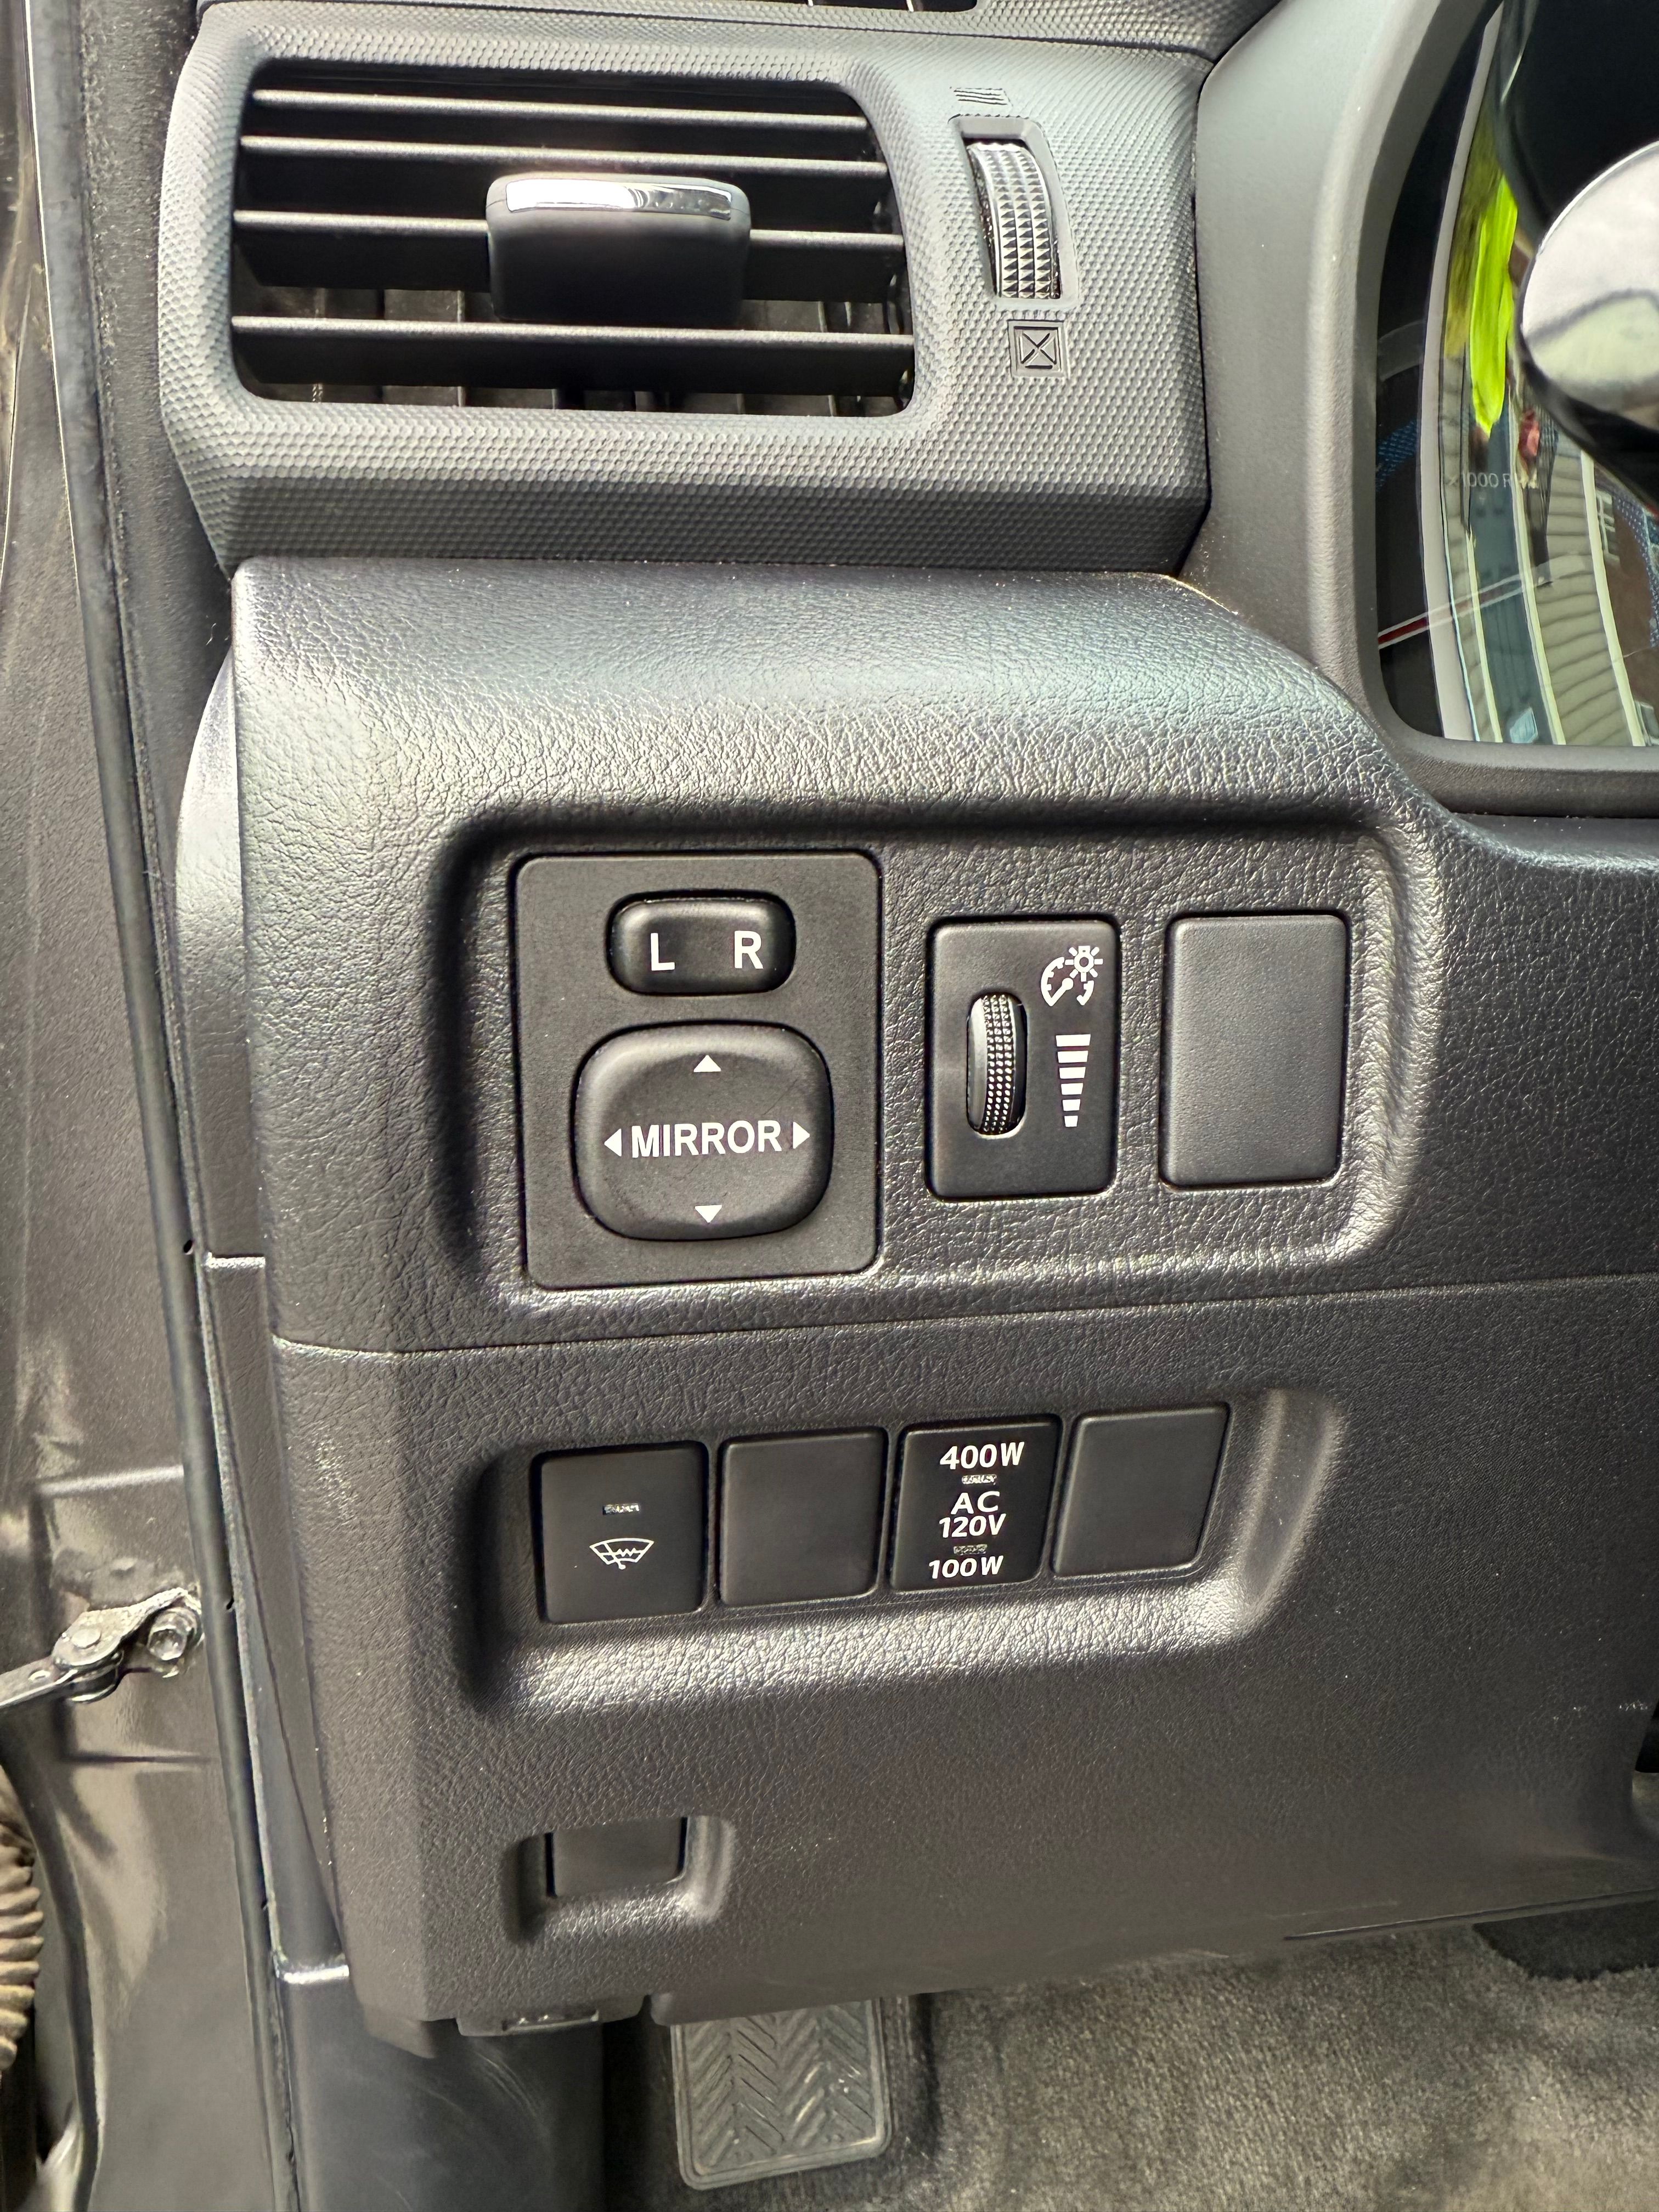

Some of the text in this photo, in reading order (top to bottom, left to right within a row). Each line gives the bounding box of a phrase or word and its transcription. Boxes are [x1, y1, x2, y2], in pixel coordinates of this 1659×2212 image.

[650, 930, 764, 971] L R
[631, 1120, 782, 1159] MIRROR
[939, 1441, 1025, 1470] 400W
[950, 1491, 1000, 1515] AC
[939, 1513, 1006, 1538] 120V
[929, 1555, 1004, 1579] 100W
